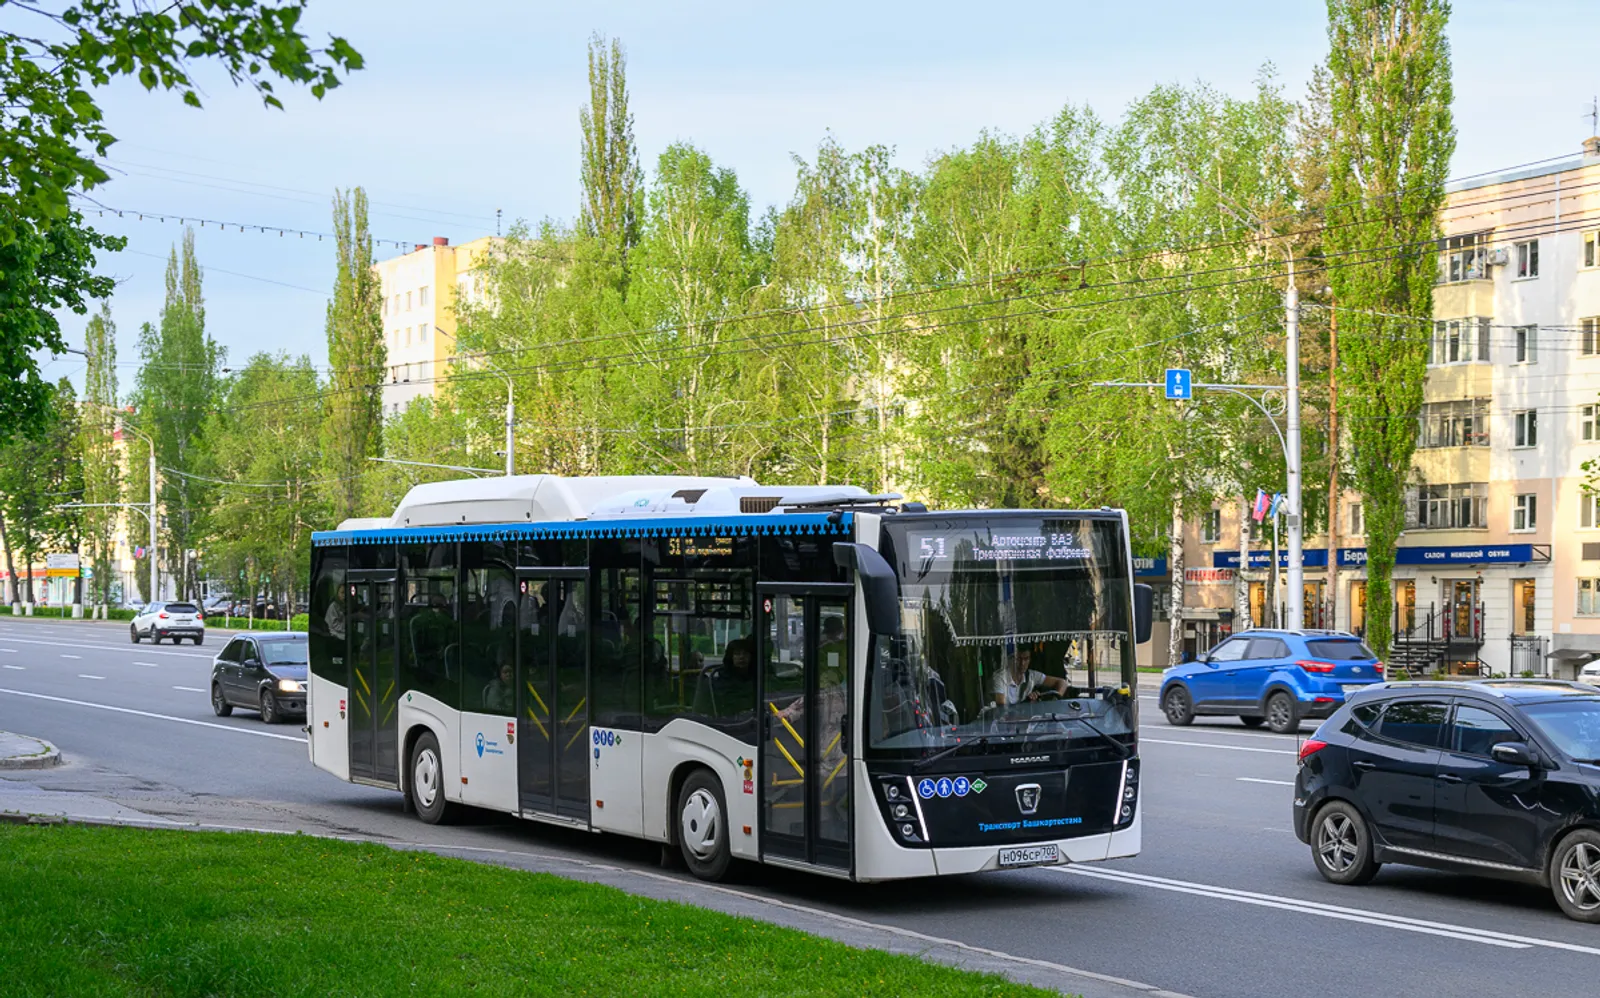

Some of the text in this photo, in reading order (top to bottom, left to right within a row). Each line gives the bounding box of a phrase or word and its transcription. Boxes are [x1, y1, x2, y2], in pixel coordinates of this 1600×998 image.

[1051, 533, 1073, 546] ВАЗ
[919, 537, 947, 558] 51
[1450, 550, 1483, 559] НЕМЕЦКОЙ
[1487, 550, 1510, 558] ОБУВИ
[978, 816, 1083, 832] Транспорт Башкортостана
